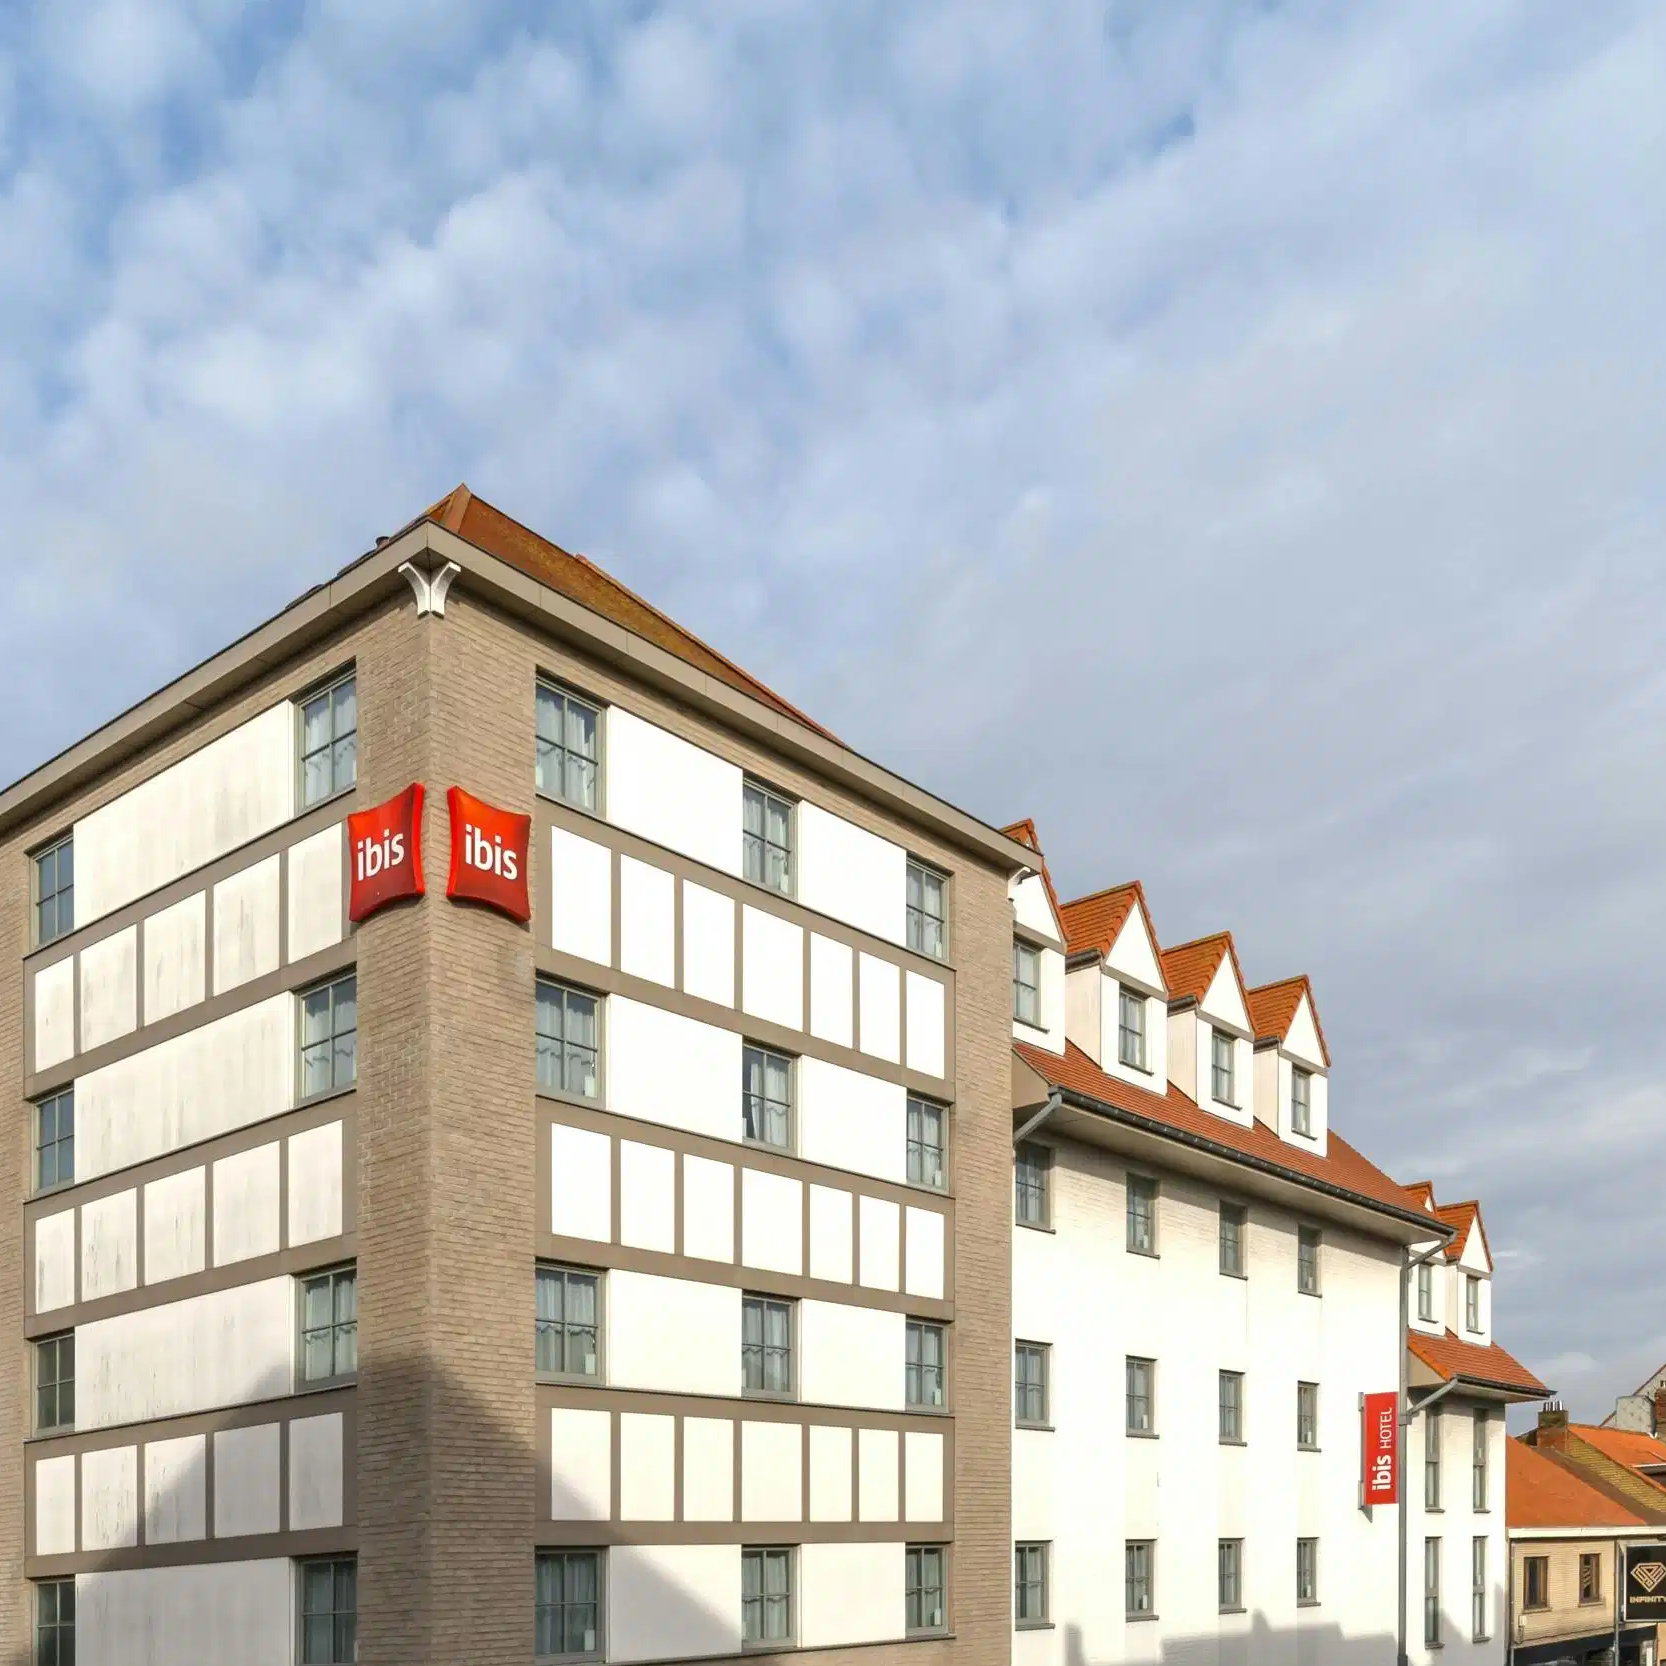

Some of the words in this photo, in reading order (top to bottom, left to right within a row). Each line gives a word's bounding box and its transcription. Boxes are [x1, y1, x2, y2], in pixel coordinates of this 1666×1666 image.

[357, 828, 405, 881] ibis
[465, 824, 518, 880] ibis
[1380, 1407, 1392, 1448] HOTEL
[1372, 1454, 1392, 1490] ibis
